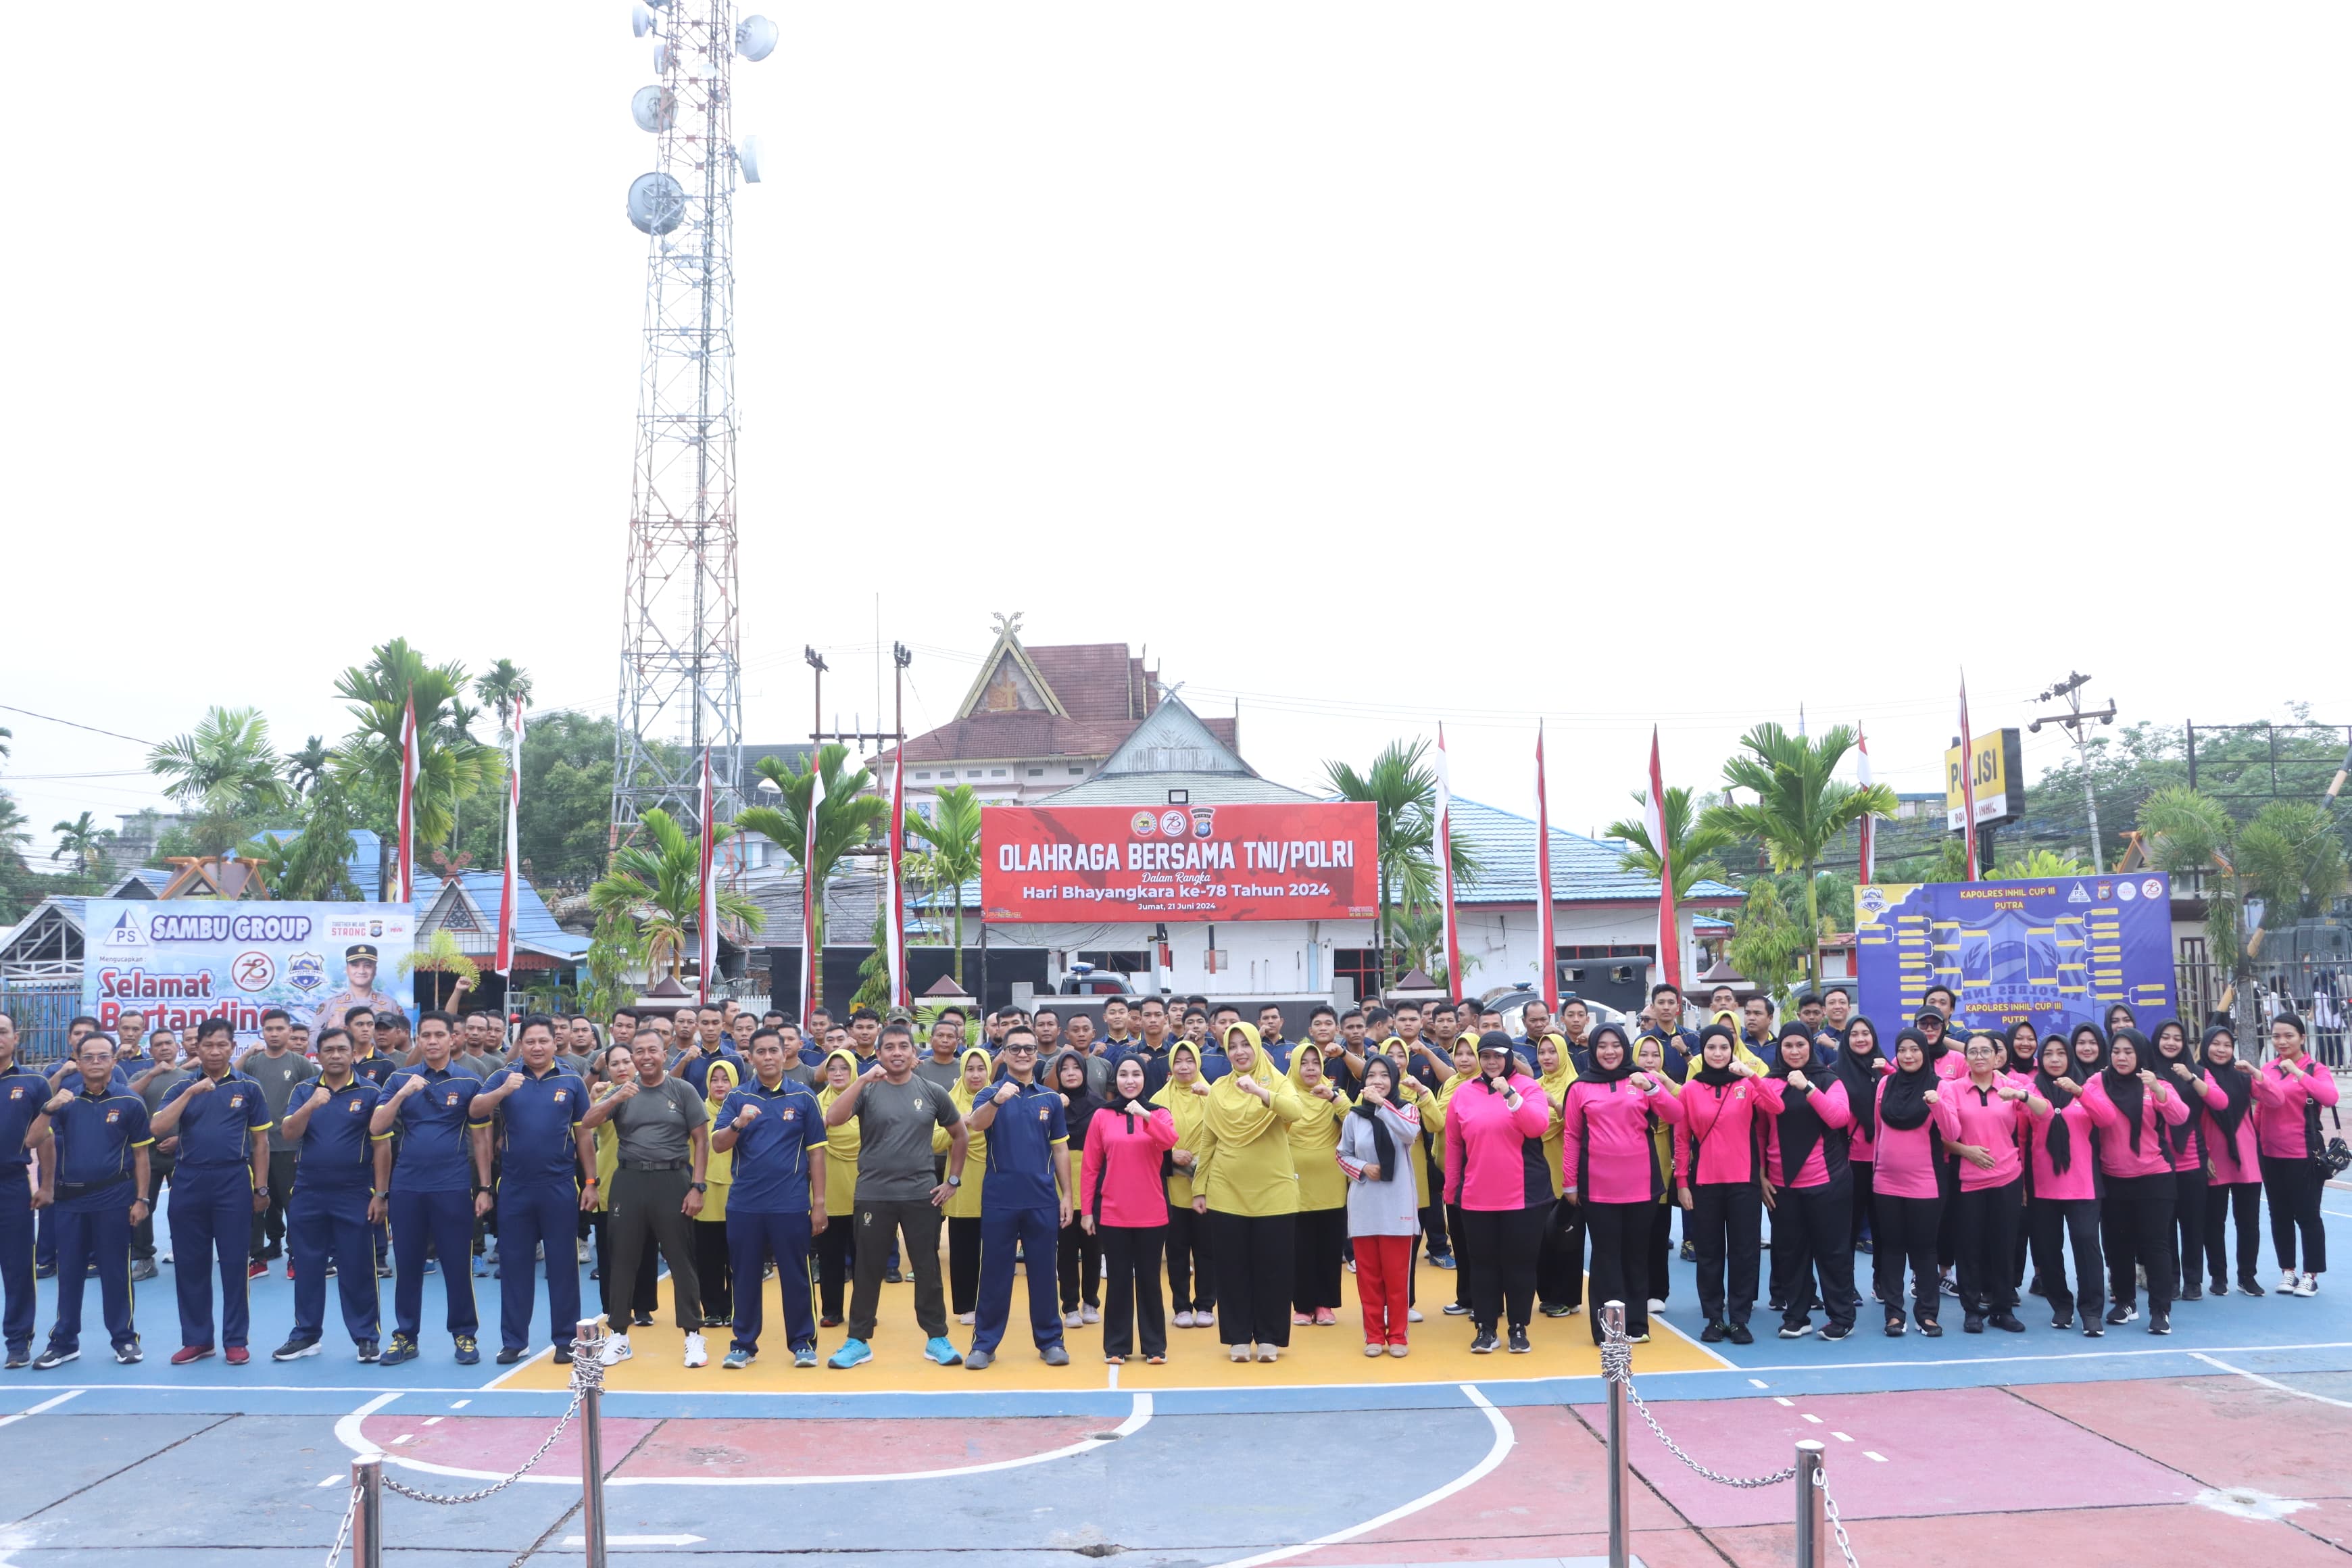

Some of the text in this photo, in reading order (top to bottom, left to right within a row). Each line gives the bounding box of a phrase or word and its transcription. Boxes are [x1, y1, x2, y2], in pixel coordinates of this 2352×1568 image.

[1951, 748, 1997, 793] PISI
[999, 840, 1354, 873] OLAHRAGA BERSAMA TNI/POLRI
[1142, 871, 1211, 885] Dalam Rangka
[1023, 883, 1330, 901] Hari Bhayangkara ke-78 Tahun 2024
[1961, 889, 2003, 899] KAPOLRES
[2005, 888, 2026, 897] INHIL
[2029, 887, 2046, 896] CUP
[1994, 901, 2024, 910] PUTRA
[151, 916, 311, 940] SAMBU GROUP
[332, 928, 366, 936] STRONG
[116, 931, 136, 943] PS
[99, 956, 142, 964] Mengucapkan
[102, 972, 211, 998] Selamat
[1965, 1003, 2009, 1012] KAPOLRES
[2011, 1002, 2032, 1011] INHIL
[2034, 1002, 2053, 1010] CUP
[2002, 1015, 2028, 1024] PUTRI
